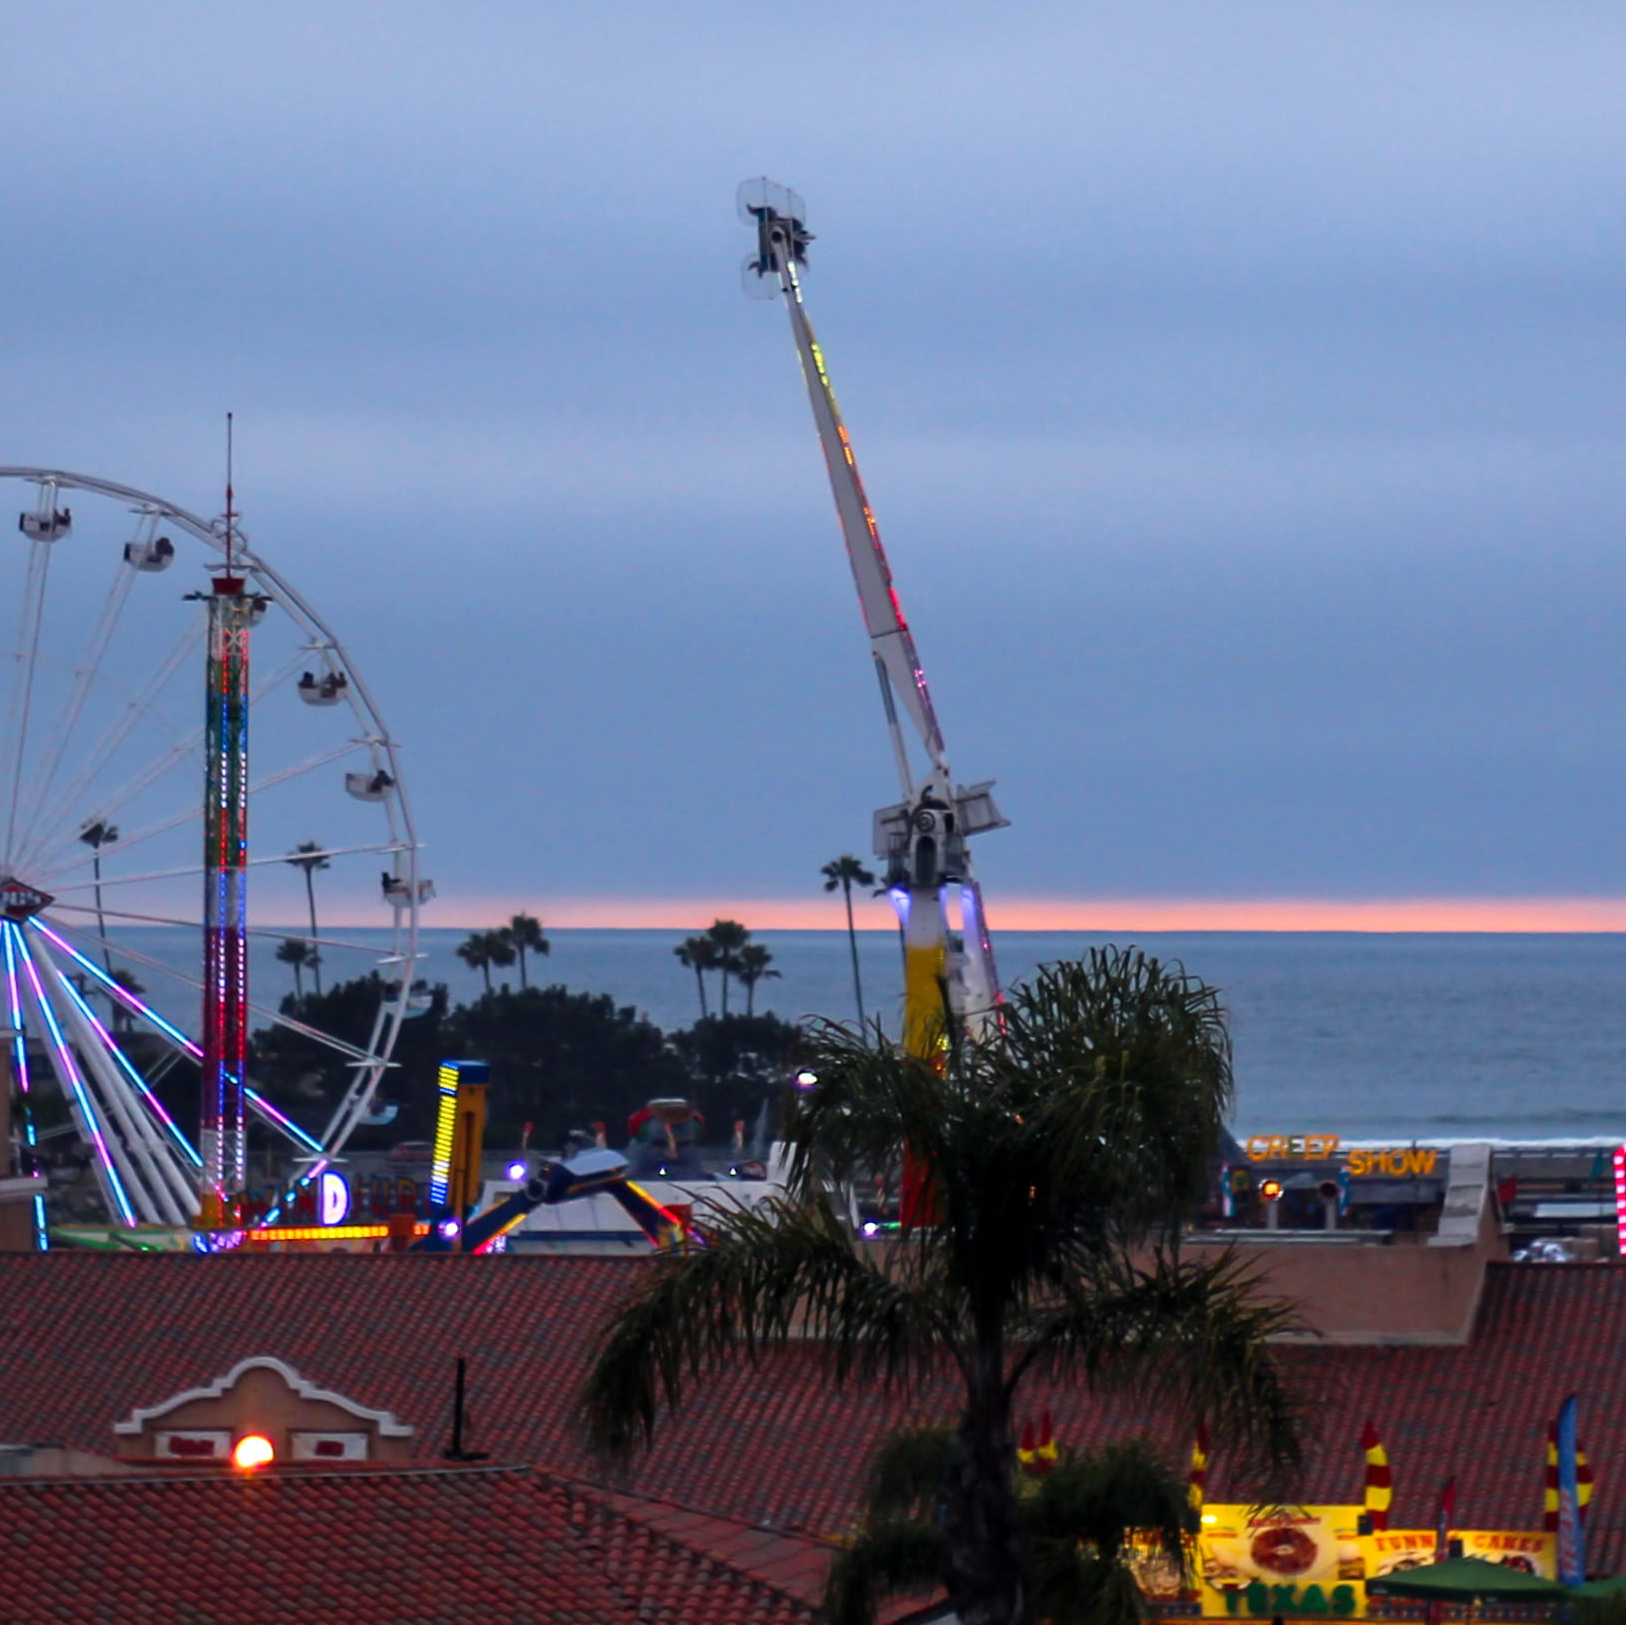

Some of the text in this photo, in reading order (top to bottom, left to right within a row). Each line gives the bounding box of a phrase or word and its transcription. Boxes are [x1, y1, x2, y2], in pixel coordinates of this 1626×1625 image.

[1246, 1134, 1339, 1161] CREEP
[1347, 1149, 1438, 1176] SHOW
[1375, 1535, 1459, 1553] FUNN
[1223, 1582, 1357, 1615] TEXAS
